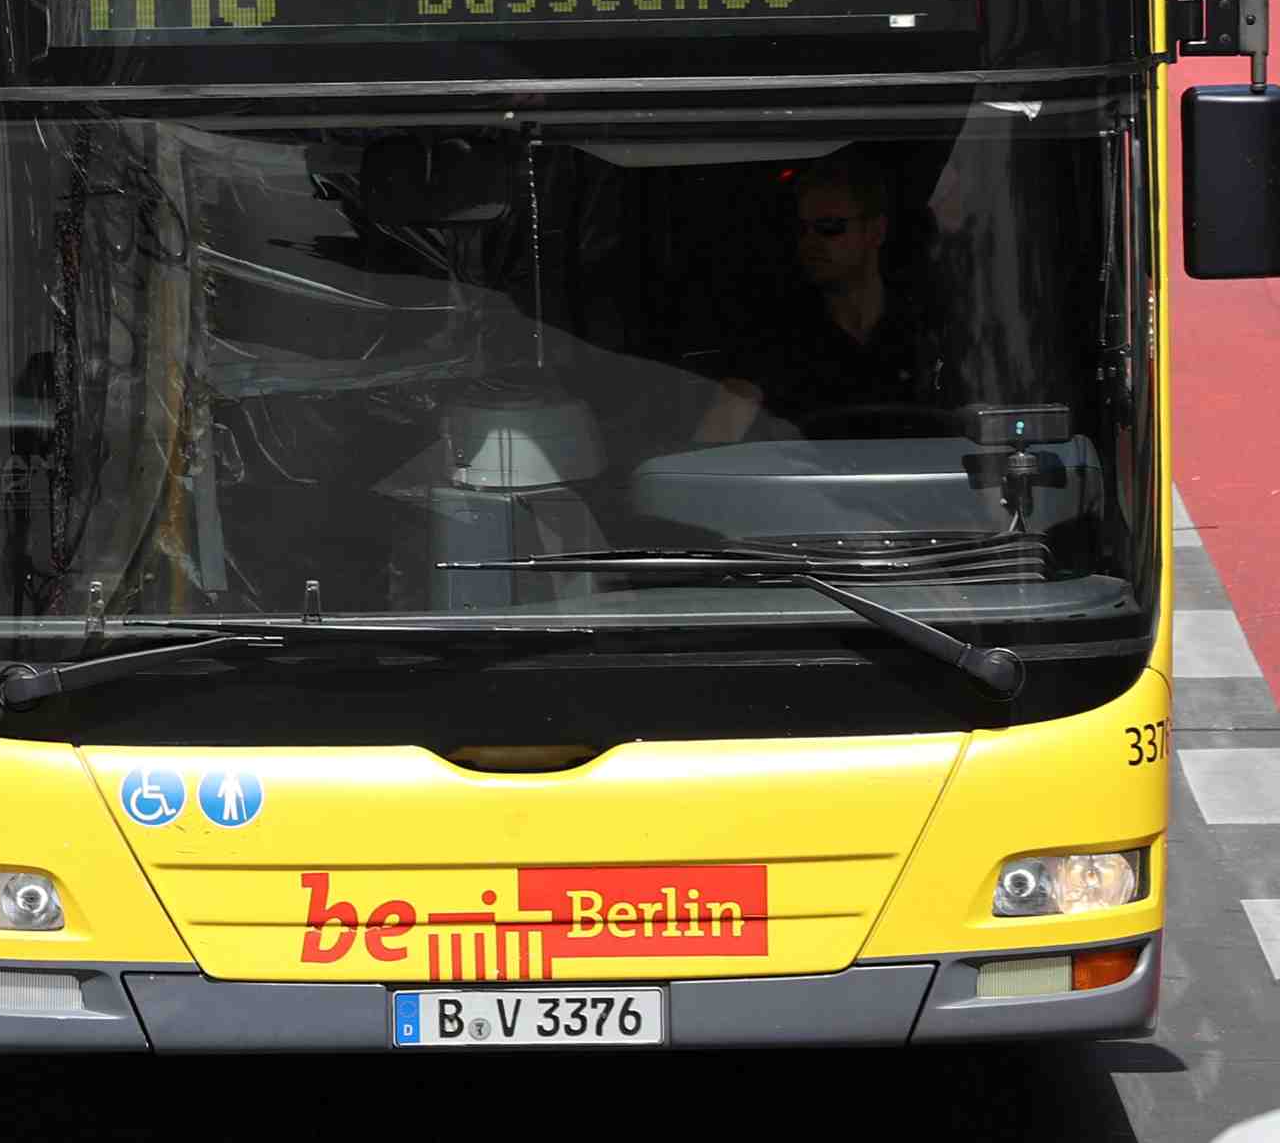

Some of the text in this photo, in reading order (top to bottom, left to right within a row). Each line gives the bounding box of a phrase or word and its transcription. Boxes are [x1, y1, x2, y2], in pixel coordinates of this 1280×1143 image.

[565, 887, 745, 940] Berlin
[438, 999, 464, 1038] B
[496, 998, 522, 1037] V
[536, 997, 642, 1037] 3376
